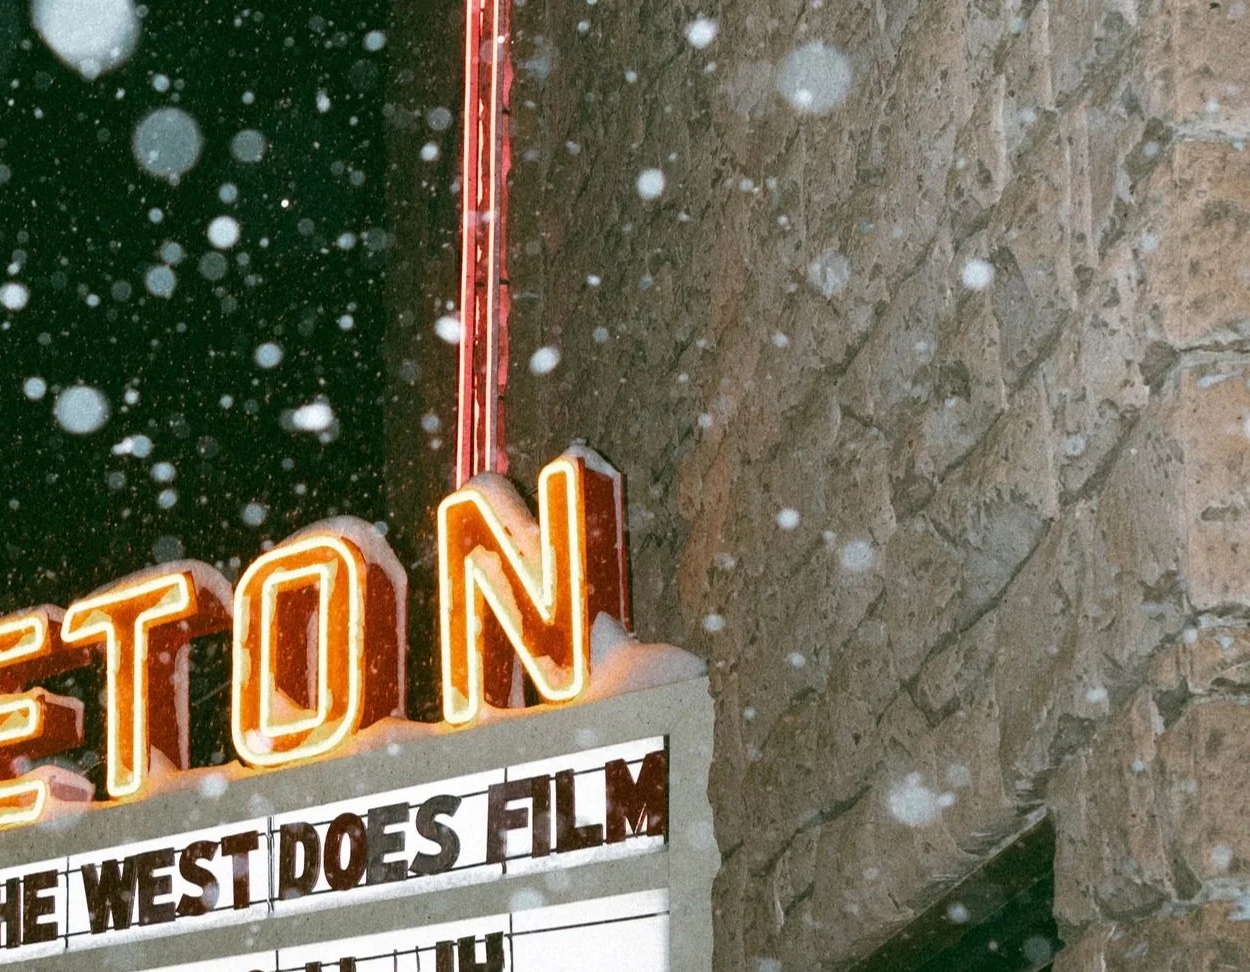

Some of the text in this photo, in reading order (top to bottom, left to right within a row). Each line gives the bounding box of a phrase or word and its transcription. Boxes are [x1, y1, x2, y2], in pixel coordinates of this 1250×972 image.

[81, 830, 259, 935] WEST
[279, 793, 462, 901] DOES
[486, 748, 670, 865] FILM
